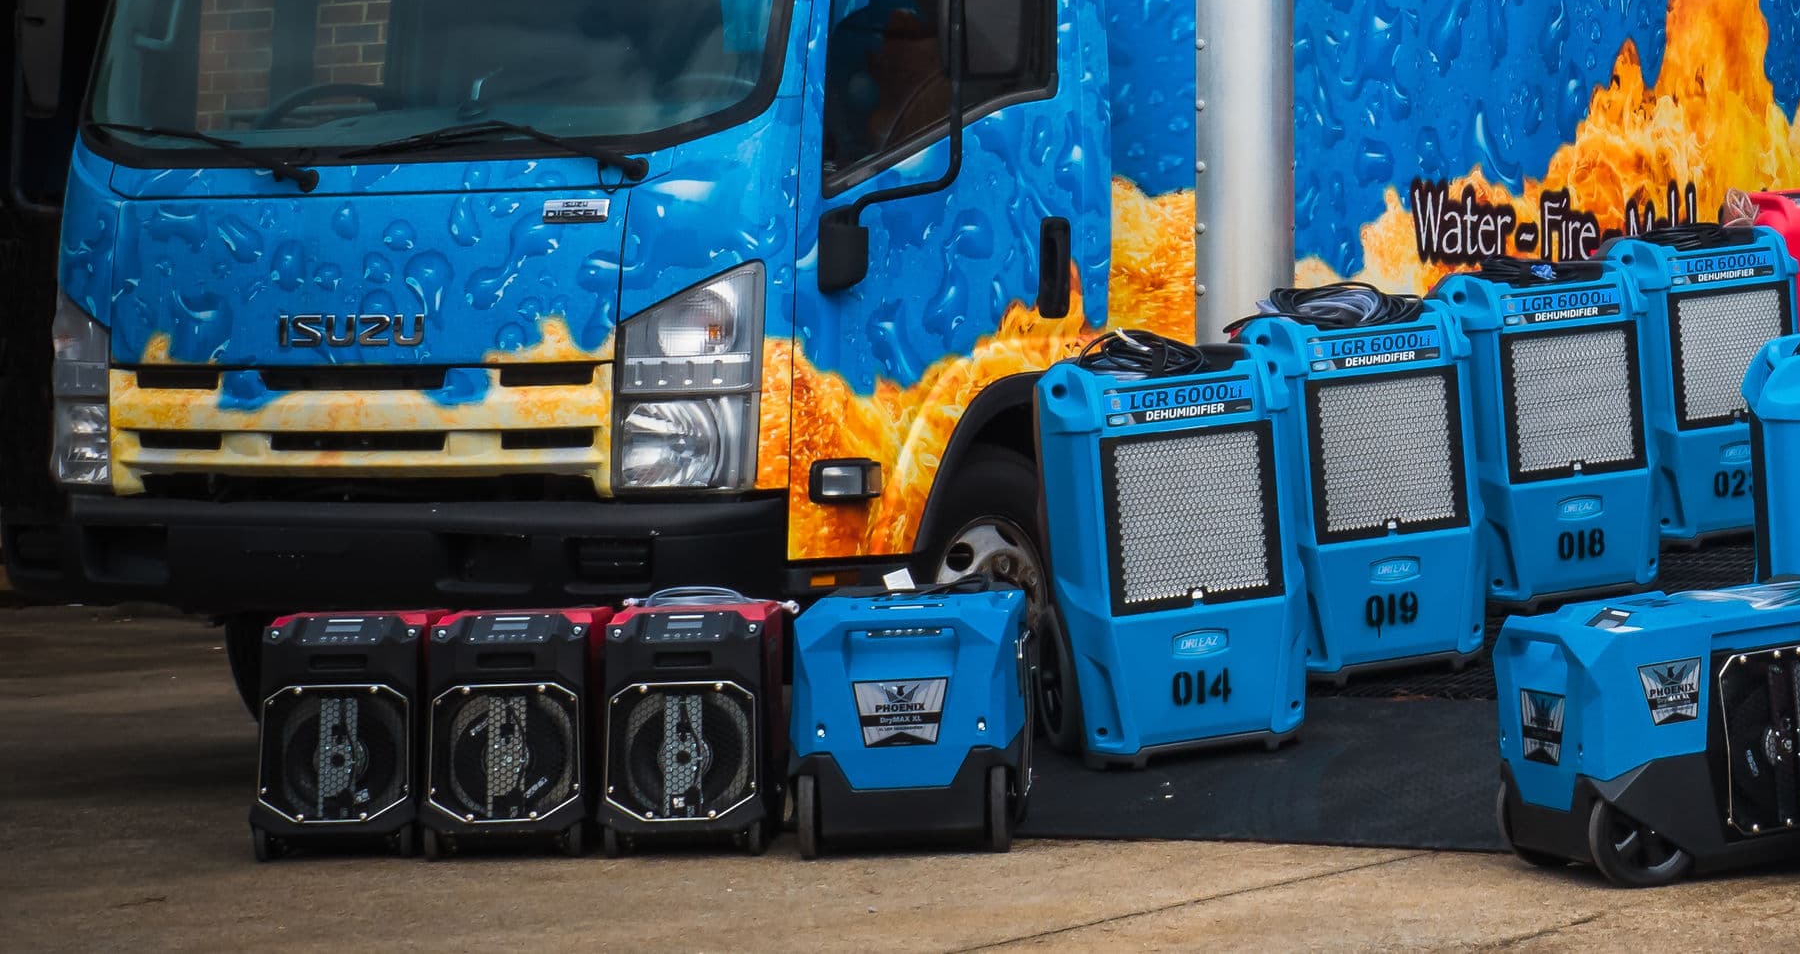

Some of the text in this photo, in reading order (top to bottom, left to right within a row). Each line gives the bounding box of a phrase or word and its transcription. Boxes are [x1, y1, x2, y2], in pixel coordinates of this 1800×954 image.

[1414, 187, 1512, 256] Water
[1542, 197, 1598, 260] Fire
[1686, 258, 1714, 273] LGR
[1698, 268, 1754, 282] DEHUMIDIFIER
[1522, 296, 1553, 312] LGR
[1535, 306, 1599, 322] DEHUMIDIFIER
[279, 314, 425, 347] ISUZU
[1330, 339, 1365, 357] LGR
[1345, 350, 1416, 367] DEHUMIDIFIER
[1129, 383, 1243, 410] LGR 6000Li
[1145, 402, 1225, 422] DEHUMIDIFIER
[1714, 469, 1752, 498] 02
[1558, 527, 1605, 560] 018
[1366, 590, 1419, 629] 019
[1172, 666, 1232, 707] 014
[1650, 681, 1695, 698] PHOENIX
[875, 702, 926, 713] PHOENIX
